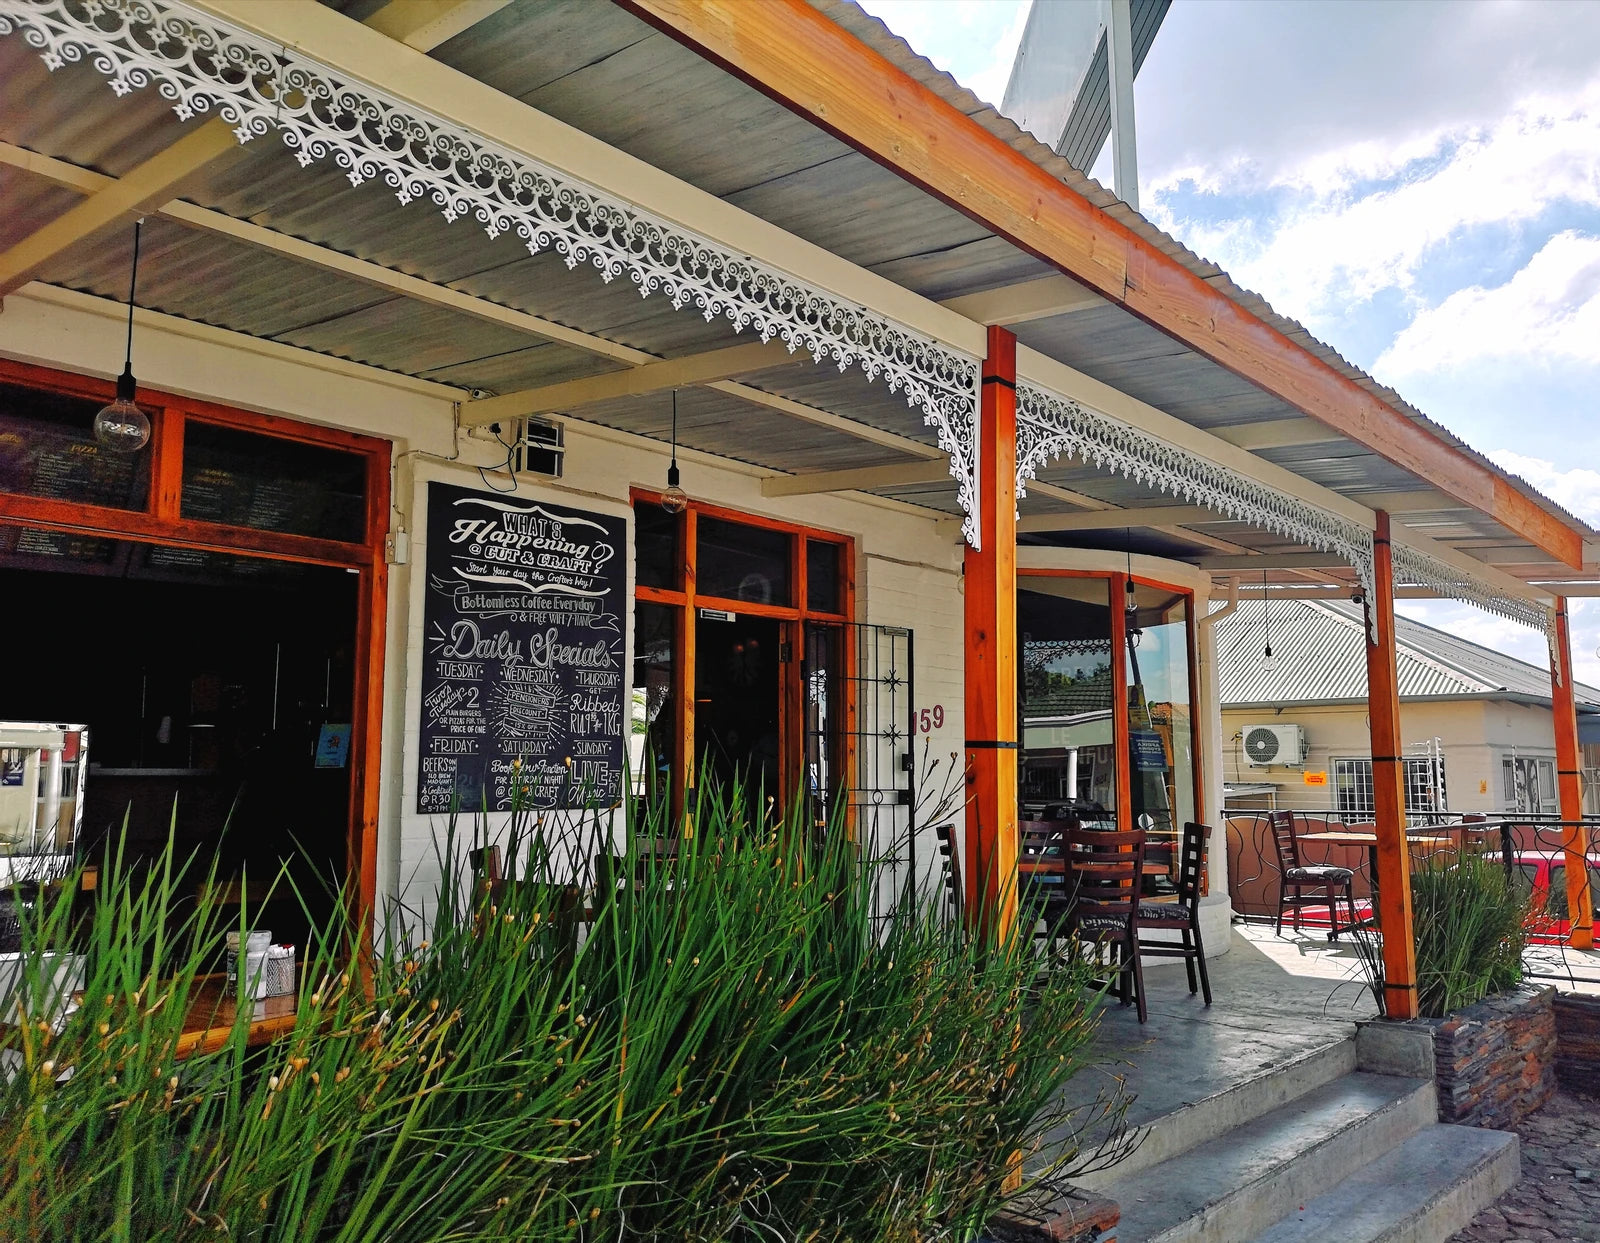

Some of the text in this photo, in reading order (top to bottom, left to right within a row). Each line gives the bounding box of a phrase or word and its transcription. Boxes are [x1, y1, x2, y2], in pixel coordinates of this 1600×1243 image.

[503, 512, 562, 539] WHAT'S
[484, 545, 520, 563] CUT
[520, 551, 534, 565] &
[537, 553, 592, 574] CRAFT
[466, 562, 487, 574] Start
[513, 569, 529, 581] day
[532, 571, 545, 581] the
[461, 594, 596, 613] Bottomless Coffee Everyday
[519, 612, 528, 622] &
[529, 612, 547, 626] FREE
[442, 619, 612, 669] Daily Specials
[438, 662, 482, 679] TUESDAY
[502, 667, 556, 684] WEDNESDAY
[578, 671, 620, 687] THURSDAY
[466, 686, 480, 708] 2
[511, 691, 550, 706] PENSIONERS
[589, 687, 602, 695] GET
[570, 693, 621, 712] Ribbed
[439, 716, 449, 725] OR
[450, 725, 467, 734] PRICE
[467, 725, 475, 733] OF
[434, 738, 475, 753] FRIDAY
[502, 740, 549, 754] SATURDAY
[576, 741, 609, 755] SUNDAY
[423, 756, 449, 772] BEERS
[495, 776, 508, 785] FOR
[570, 760, 609, 785] LIVE
[534, 785, 560, 798] CRAFT
